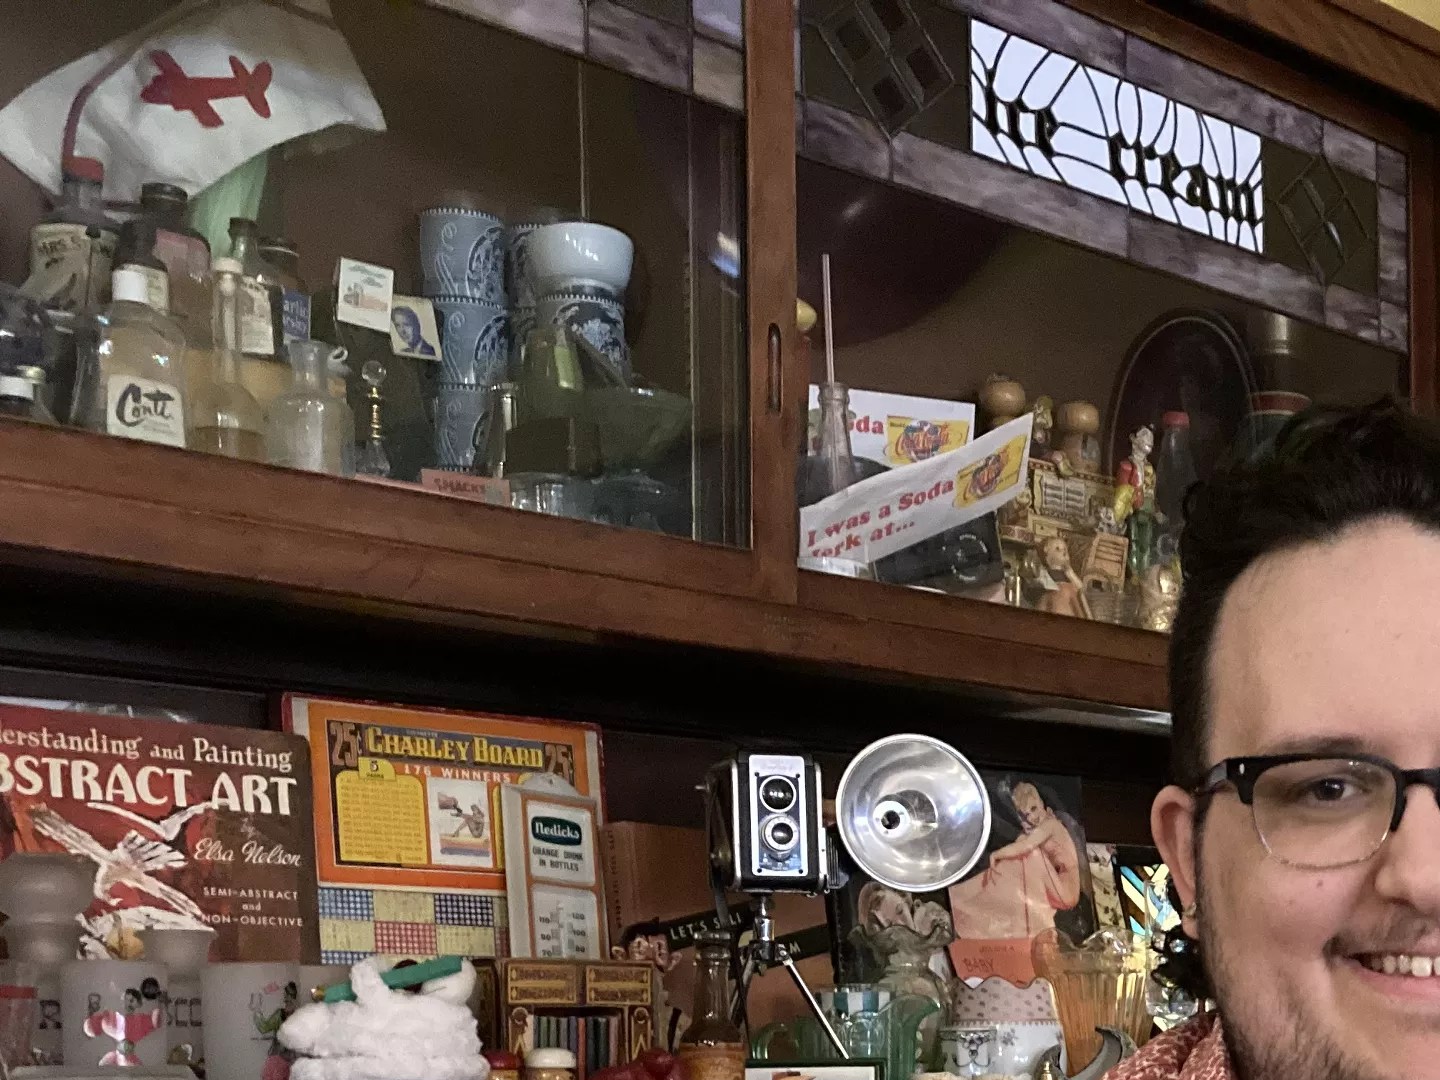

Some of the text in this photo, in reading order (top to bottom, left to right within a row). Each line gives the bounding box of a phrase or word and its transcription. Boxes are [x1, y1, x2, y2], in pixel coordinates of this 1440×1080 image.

[824, 510, 871, 537] was
[878, 503, 891, 519] a
[898, 479, 954, 512] Soda
[0, 726, 293, 773] erstanding and Painting
[366, 726, 470, 762] CHARLEY
[472, 735, 544, 769] BOARD
[440, 767, 511, 783] WINNERS
[211, 771, 298, 816] ART
[534, 822, 580, 840] Nedicks
[241, 840, 302, 867] Nelson
[203, 886, 299, 901] SEMI-ABSTRACT
[241, 901, 262, 912] and
[201, 914, 304, 928] NON-OBJECTIVE
